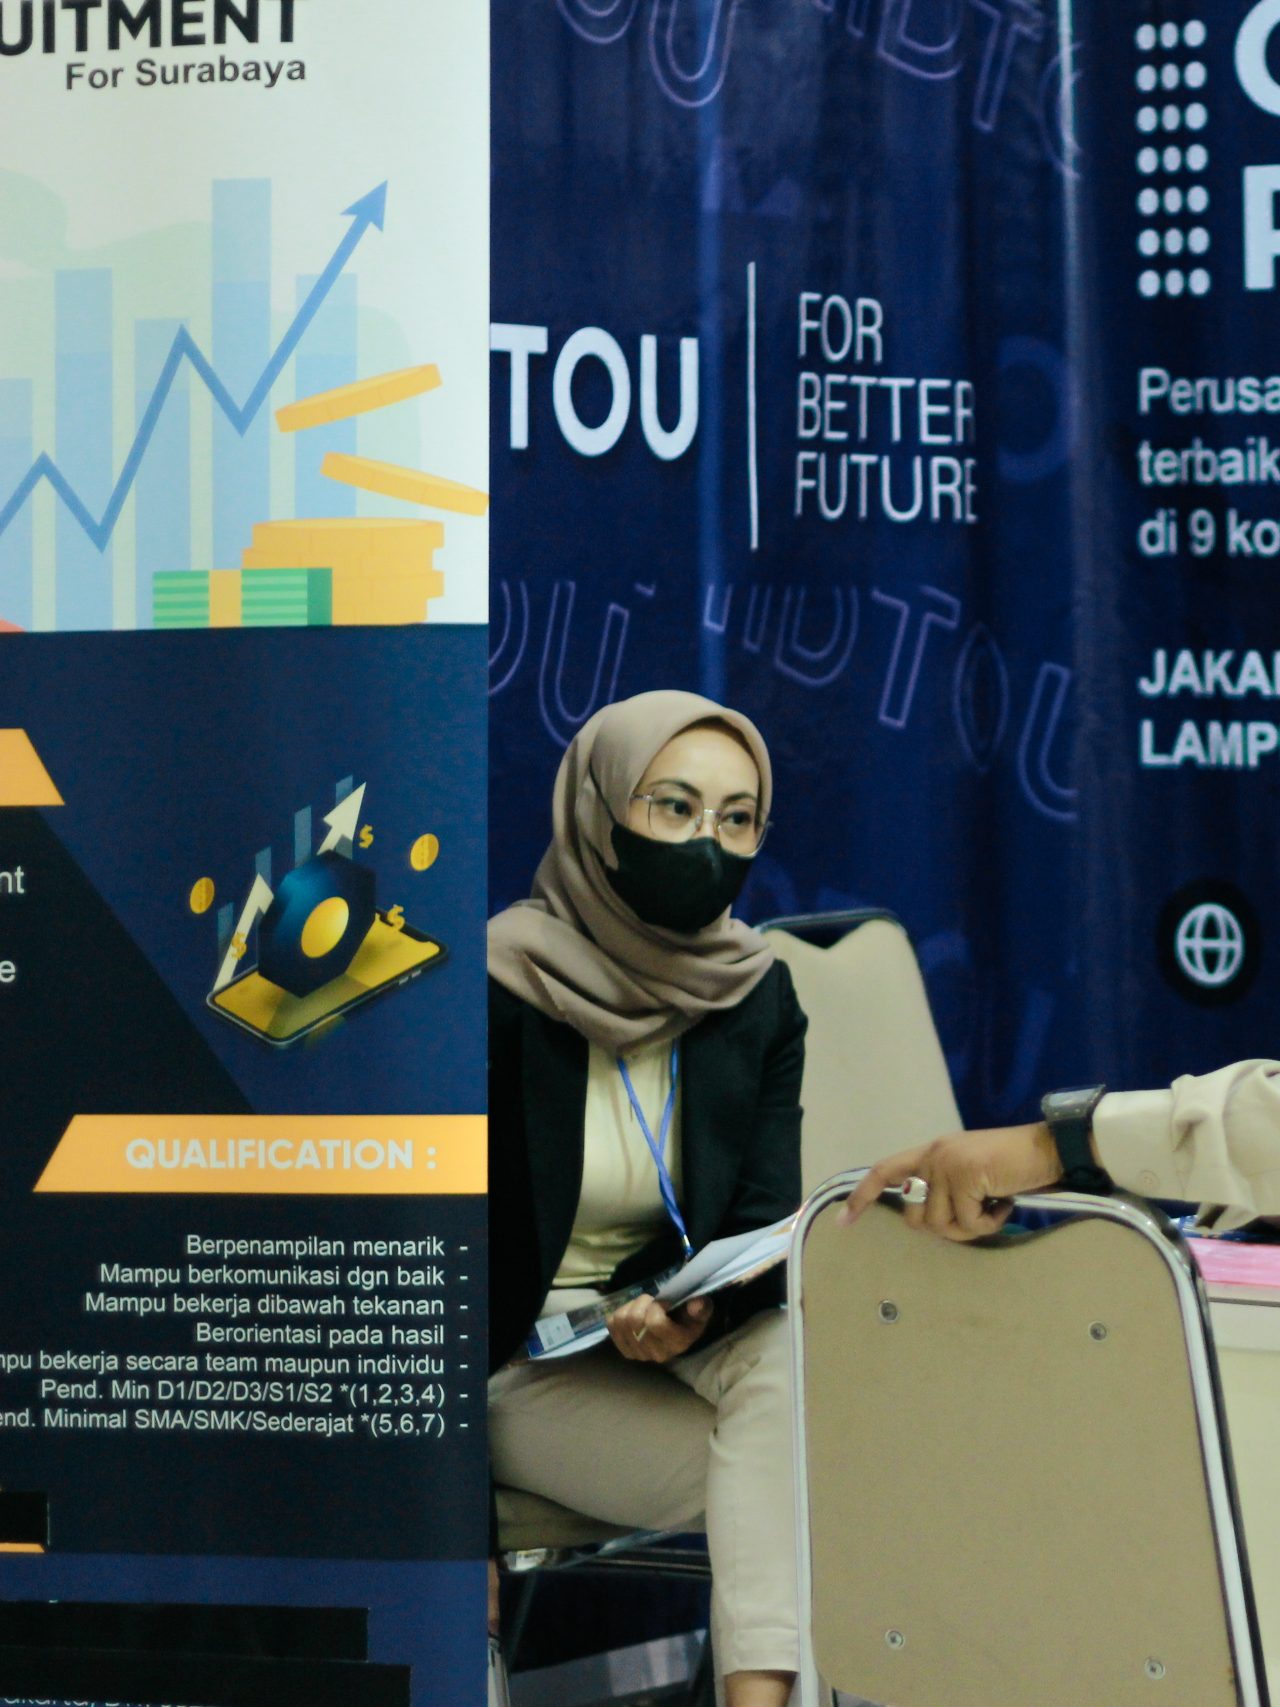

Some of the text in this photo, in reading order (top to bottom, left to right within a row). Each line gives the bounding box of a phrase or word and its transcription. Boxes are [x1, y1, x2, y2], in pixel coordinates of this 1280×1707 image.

[66, 54, 307, 91] For Surabaya
[798, 291, 884, 364] FOR
[797, 371, 974, 445] BETTER
[795, 450, 977, 523] FUTURE
[1138, 509, 1178, 556] di
[1189, 508, 1216, 556] 9
[124, 1138, 414, 1170] QUALIFICATION
[186, 1234, 345, 1259] Berpenampilan
[353, 1235, 445, 1256] menarik
[100, 1263, 181, 1288] Mampu
[188, 1263, 340, 1286] berkomunikasi
[346, 1265, 389, 1290] dgn
[397, 1265, 445, 1286] baik
[85, 1291, 166, 1317] Mampu
[173, 1292, 251, 1318] bekerja
[257, 1293, 346, 1315] dibawah
[352, 1295, 445, 1316] tekanan
[196, 1322, 322, 1344] Berorientasi
[329, 1324, 384, 1349] pada
[391, 1324, 444, 1345] hasil
[39, 1349, 119, 1375] bekerja
[125, 1354, 199, 1372] secara
[204, 1352, 258, 1372] team
[264, 1357, 350, 1378] maupun
[357, 1353, 445, 1375] individu
[41, 1378, 103, 1400] Pend.
[111, 1379, 150, 1400] Min
[157, 1379, 333, 1403] D1/D2/D3/S1/S2
[44, 1407, 127, 1429] Minimal
[134, 1409, 355, 1437] SMA/SMK/Sederajat
